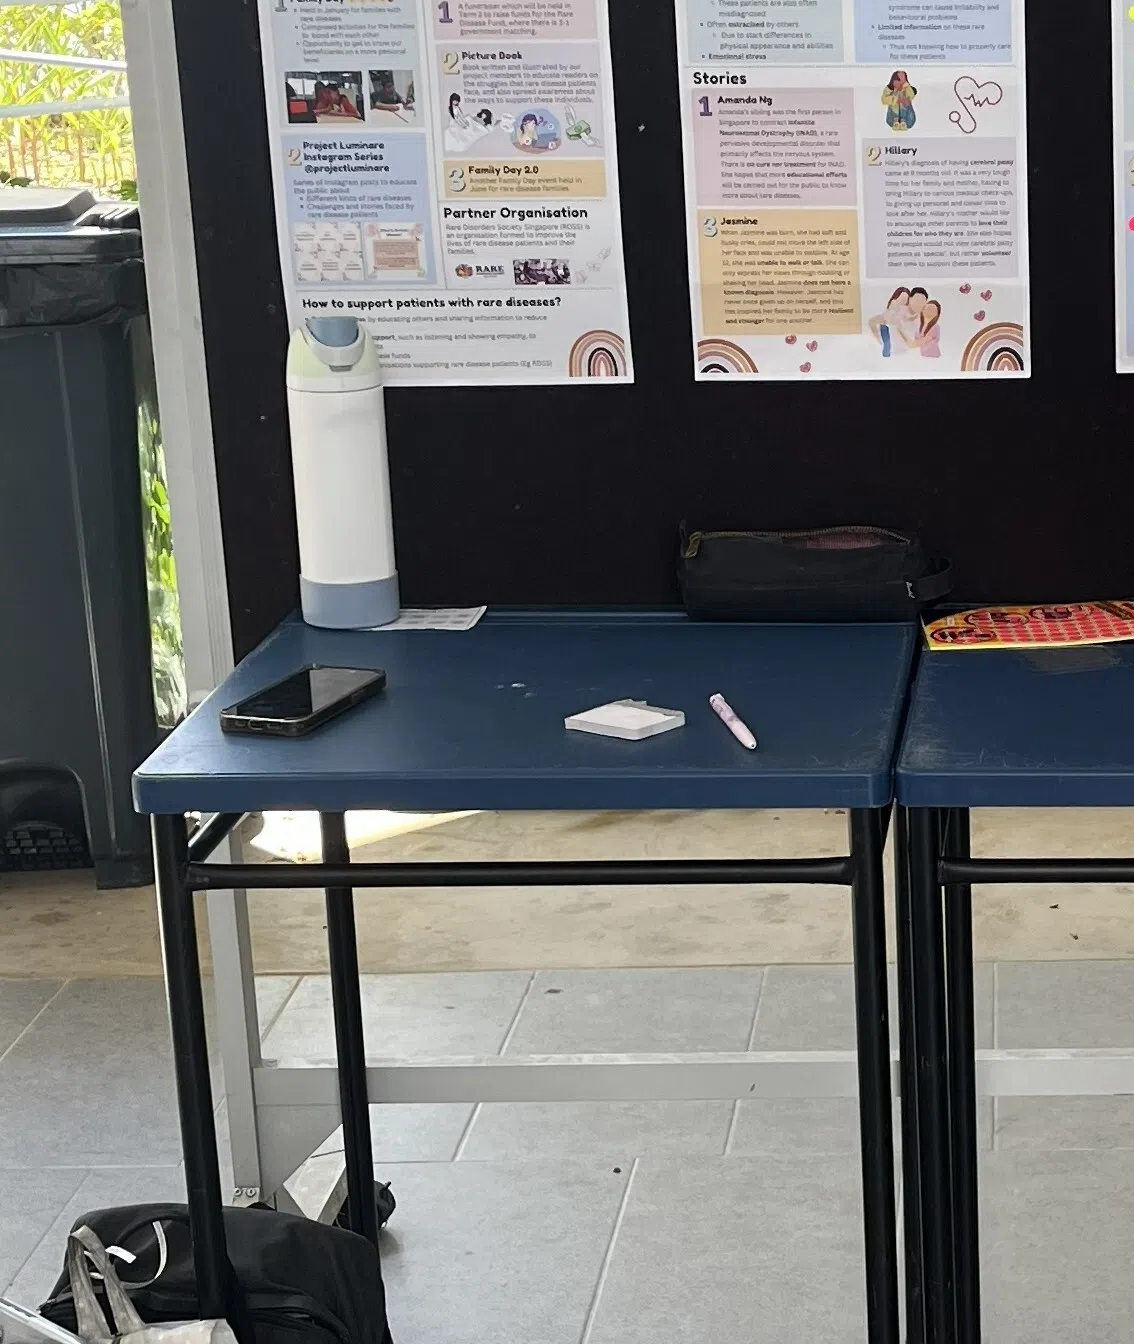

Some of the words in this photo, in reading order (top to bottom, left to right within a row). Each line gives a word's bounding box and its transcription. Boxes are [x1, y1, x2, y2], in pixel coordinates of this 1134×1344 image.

[438, 1, 453, 23] 1
[462, 52, 496, 60] Picture
[693, 72, 747, 84] Stories
[717, 96, 756, 104] Amanda
[759, 96, 772, 105] Ng
[698, 96, 712, 116] 1
[303, 142, 337, 151] Project
[340, 141, 384, 150] Luminare
[885, 147, 917, 156] Hillary
[304, 153, 352, 162] Instagram
[355, 152, 384, 161] Series
[304, 164, 390, 174] @projectluminare
[468, 166, 500, 175] Family
[503, 166, 521, 175] Day
[525, 166, 539, 174] 2.0
[444, 208, 496, 219] Partner
[501, 207, 588, 221] Organisation
[721, 216, 758, 225] Jasmine
[476, 265, 504, 273] RARE
[302, 299, 328, 308] How
[331, 299, 343, 307] to
[347, 299, 393, 310] support
[397, 298, 445, 309] patients
[449, 297, 473, 307] with
[477, 298, 502, 307] rare
[506, 297, 561, 307] diseases?
